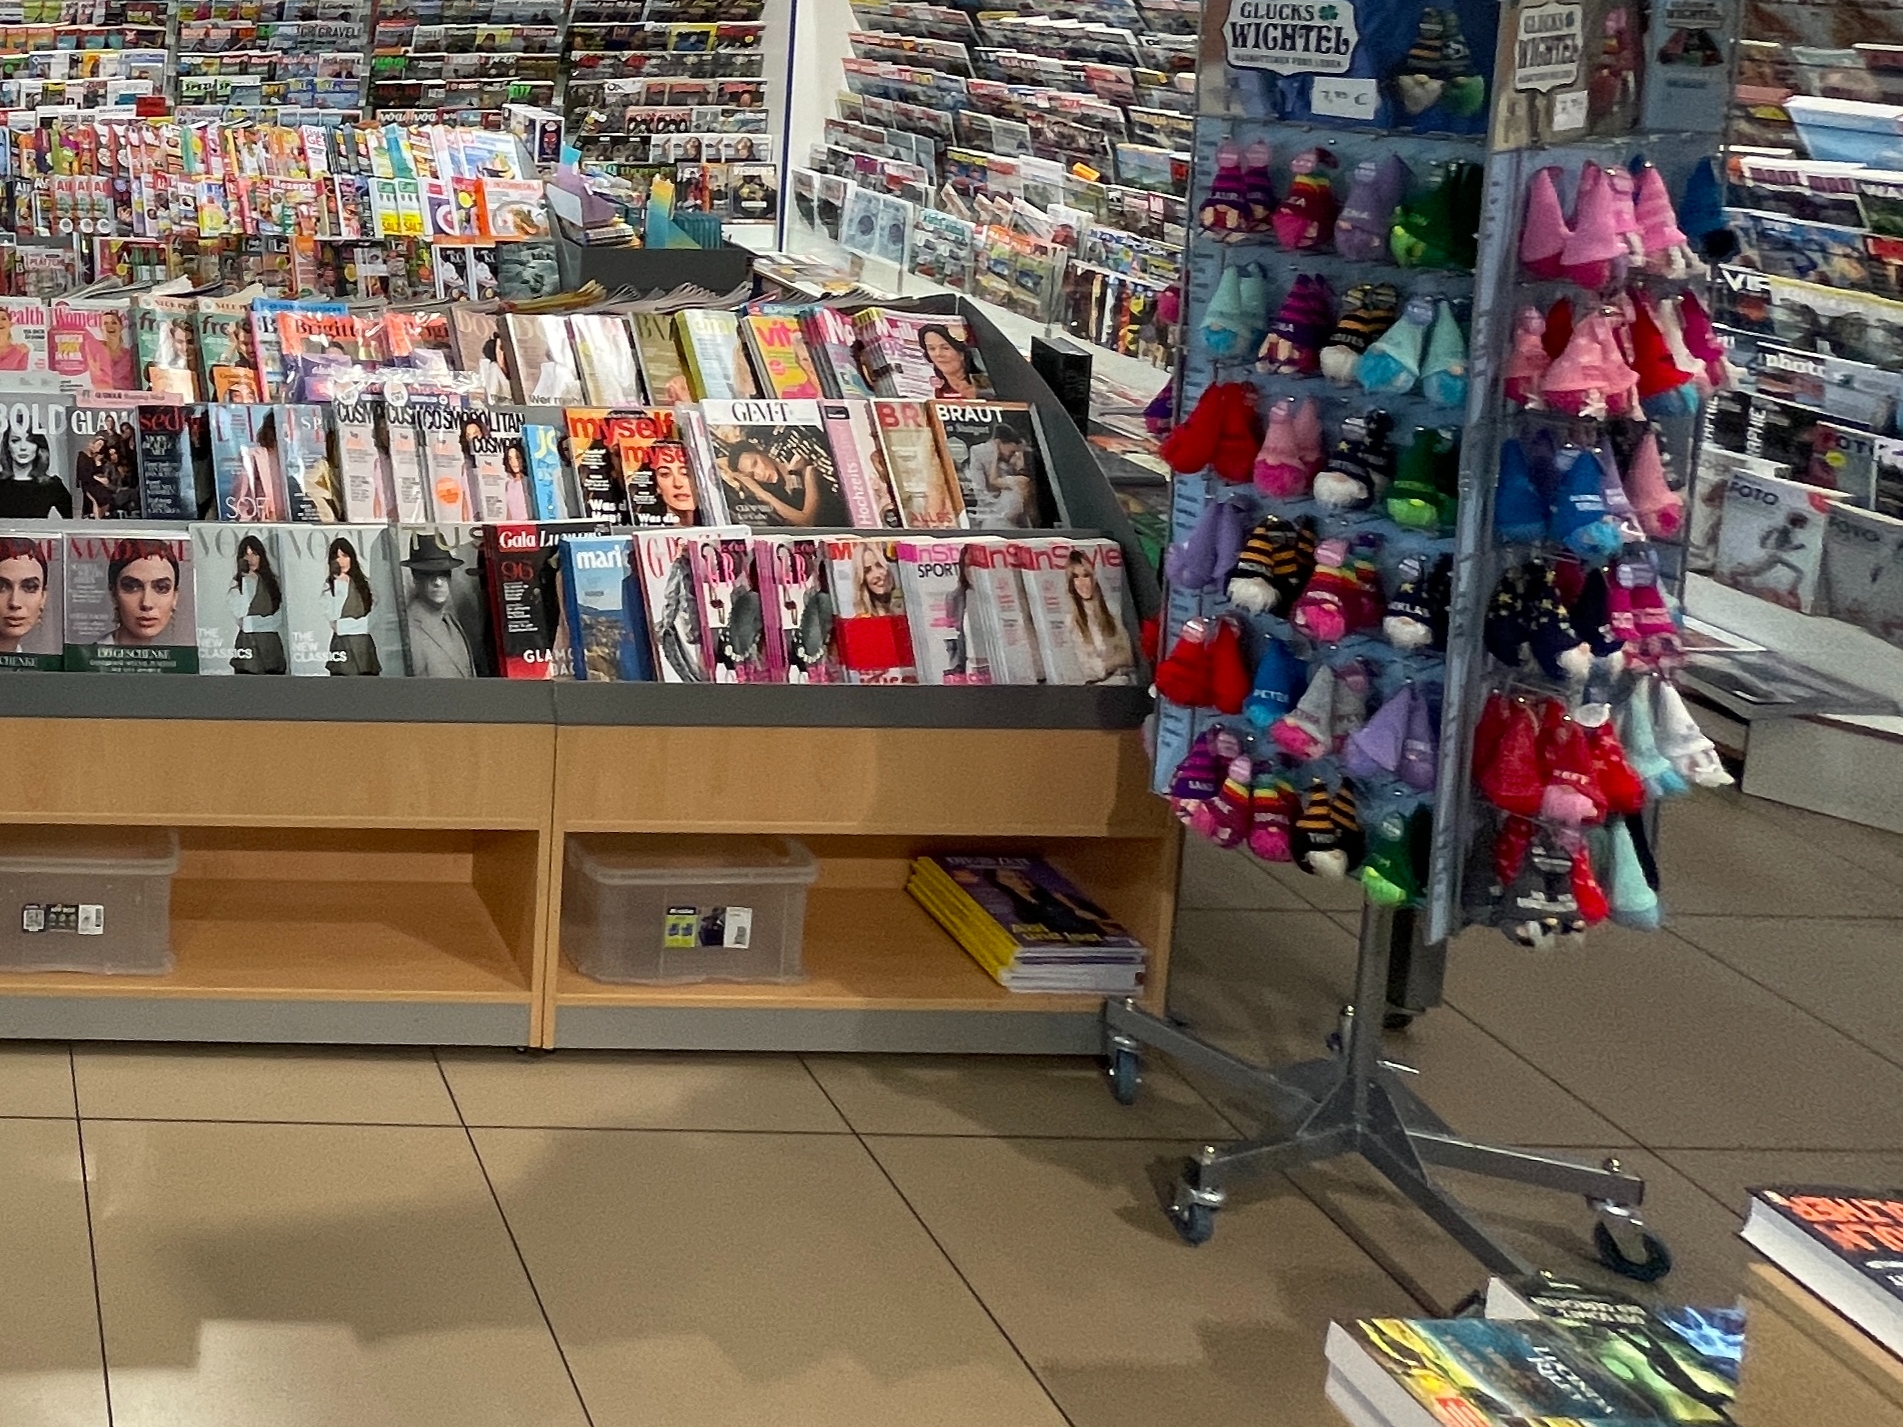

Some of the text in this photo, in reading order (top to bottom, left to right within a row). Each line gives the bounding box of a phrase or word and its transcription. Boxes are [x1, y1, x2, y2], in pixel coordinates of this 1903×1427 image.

[935, 403, 1003, 423] BRAUT
[569, 412, 674, 444] myself
[498, 531, 537, 549] Gala
